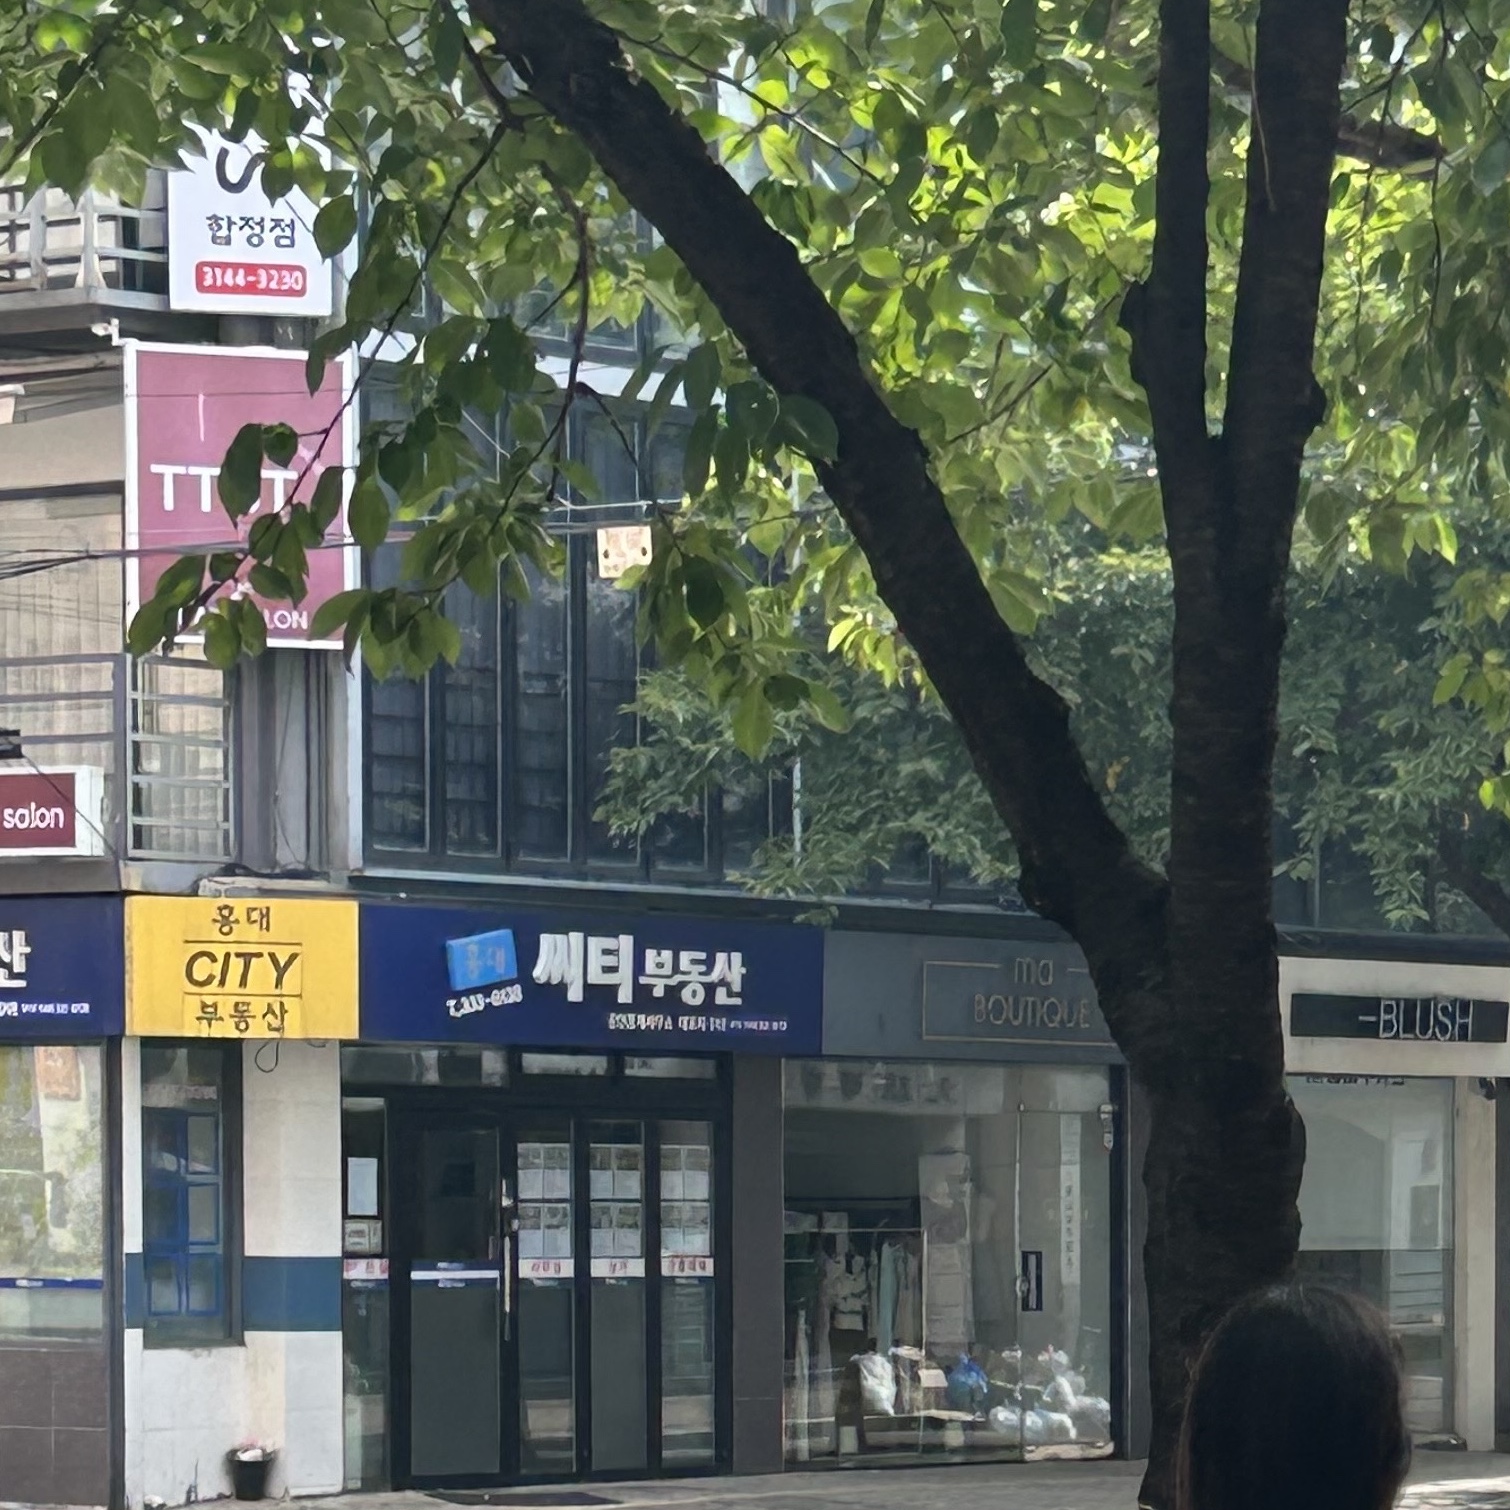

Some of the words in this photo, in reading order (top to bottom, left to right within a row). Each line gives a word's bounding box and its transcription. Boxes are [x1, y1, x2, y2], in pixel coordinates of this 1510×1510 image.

[205, 214, 296, 248] 합정점
[185, 950, 300, 990] CITY
[531, 931, 634, 1004] 씨티
[638, 948, 748, 1006] 부동산
[195, 1000, 289, 1036] 부동산
[973, 993, 1091, 1029] BOUTIQUE
